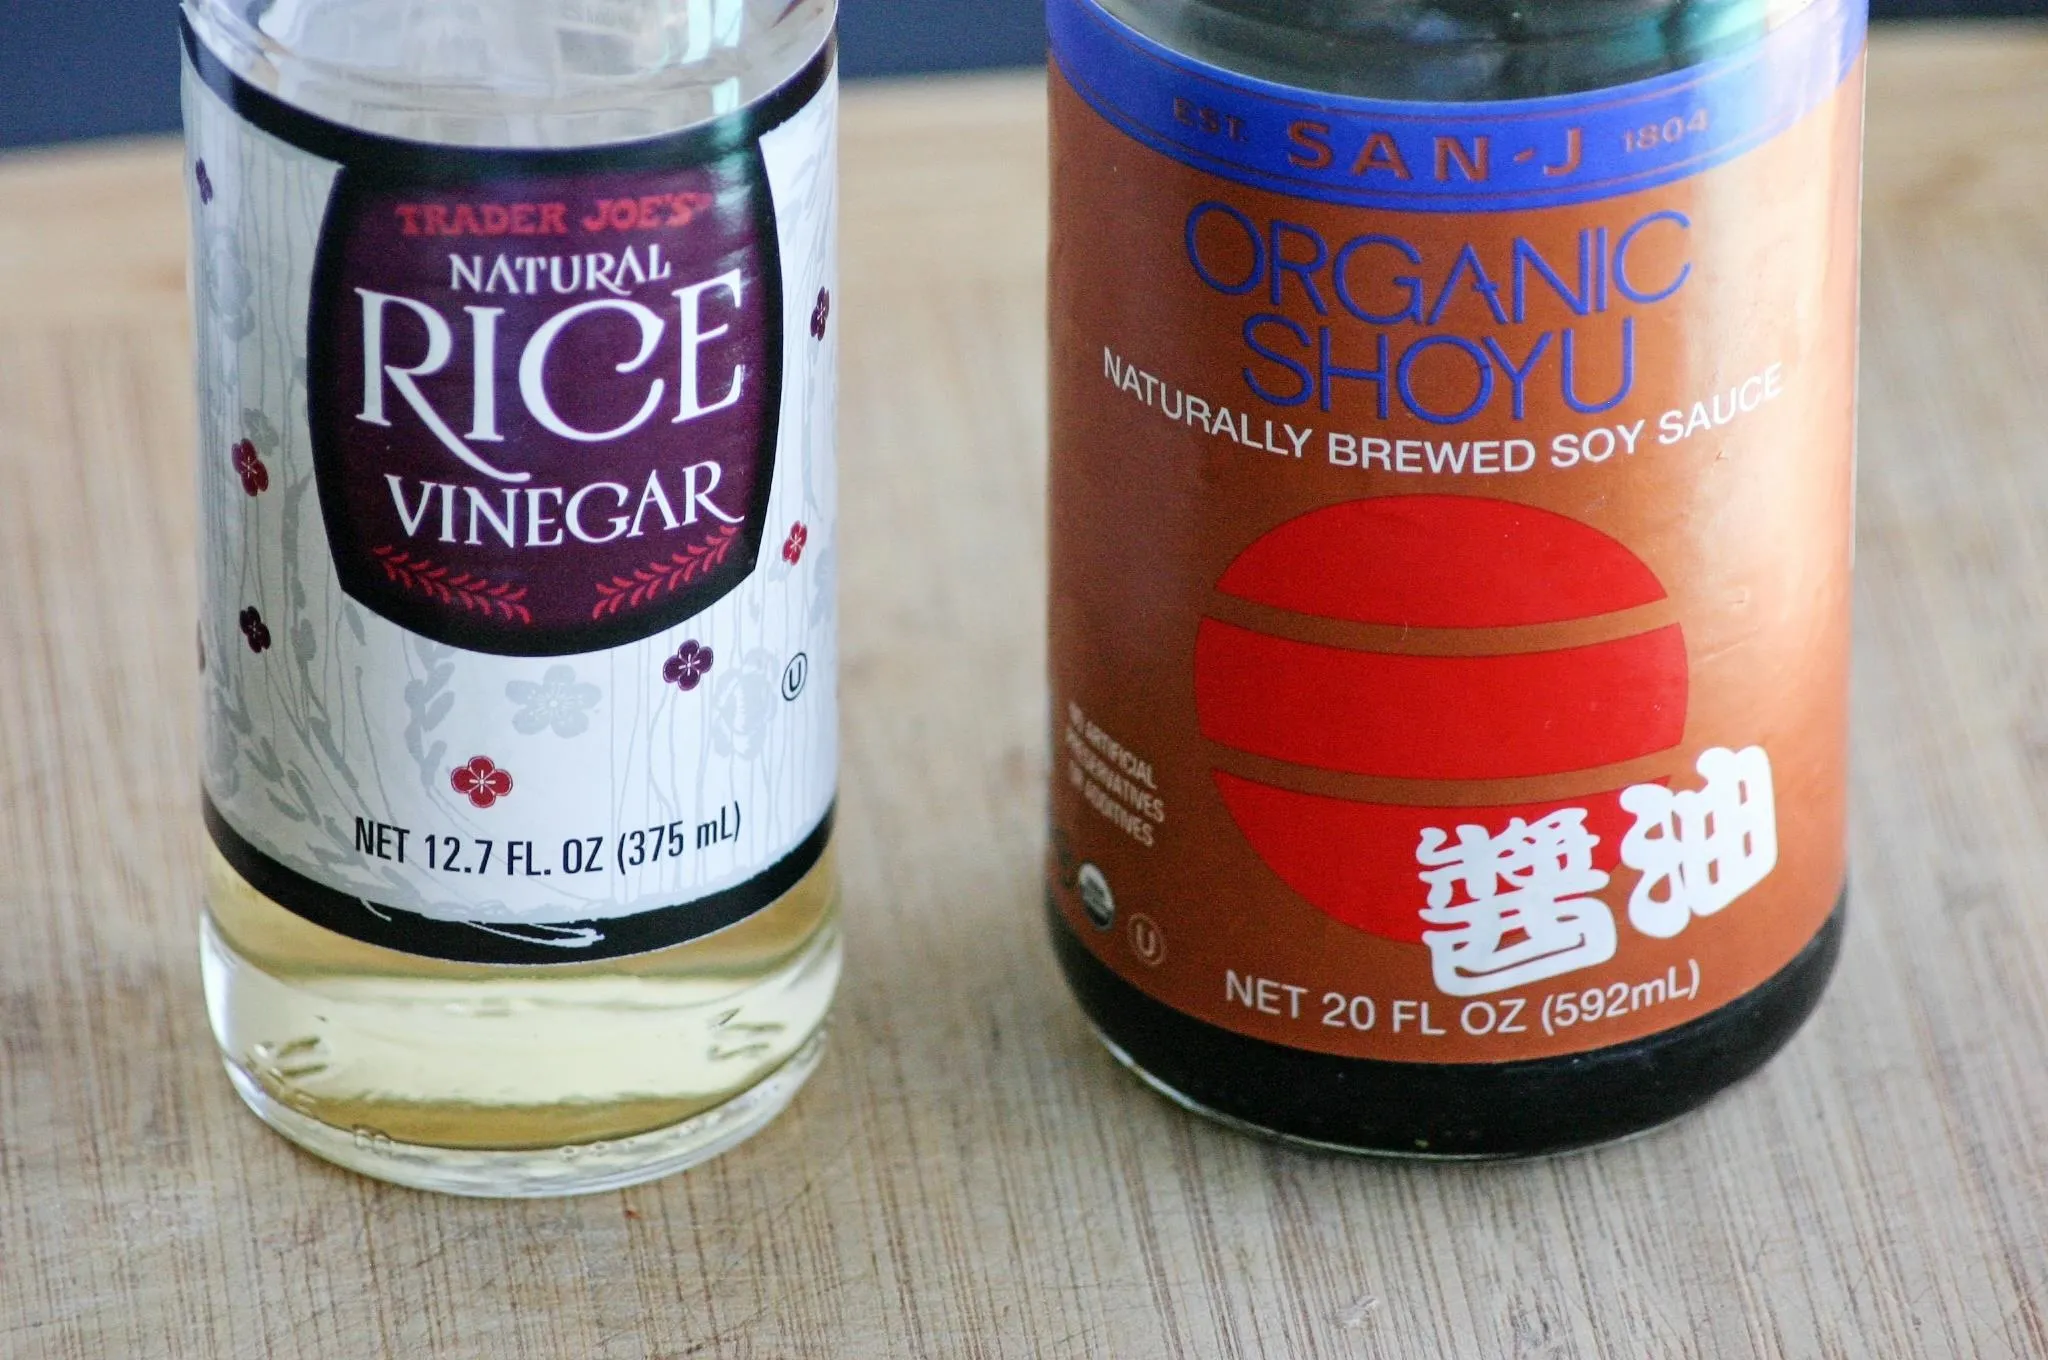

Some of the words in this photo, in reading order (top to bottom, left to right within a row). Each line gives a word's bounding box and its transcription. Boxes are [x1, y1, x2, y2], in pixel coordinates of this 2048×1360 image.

[1619, 108, 1709, 154] 1804
[394, 202, 567, 237] TRADER
[449, 243, 671, 297] NATURAL
[1183, 202, 1692, 326] ORGANIC
[353, 268, 744, 482] RICE
[1103, 345, 1313, 459] NATURALLY
[1327, 431, 1536, 474] BREWED
[1551, 419, 1646, 469] SOY
[1658, 360, 1784, 446] SAUCE
[1241, 312, 1636, 426] SHOYU
[383, 459, 745, 549] VINEGAR
[354, 815, 411, 863] NET
[423, 835, 493, 875] 12.7
[506, 841, 552, 877] FL.
[562, 837, 605, 874] OZ
[616, 818, 684, 876] (375
[696, 799, 743, 852] mL)
[1224, 968, 1308, 1018] NET
[1321, 990, 1376, 1032] 20
[1392, 1000, 1446, 1036] FL
[1459, 997, 1527, 1034] OZ
[1541, 959, 1701, 1036] (592mL)
